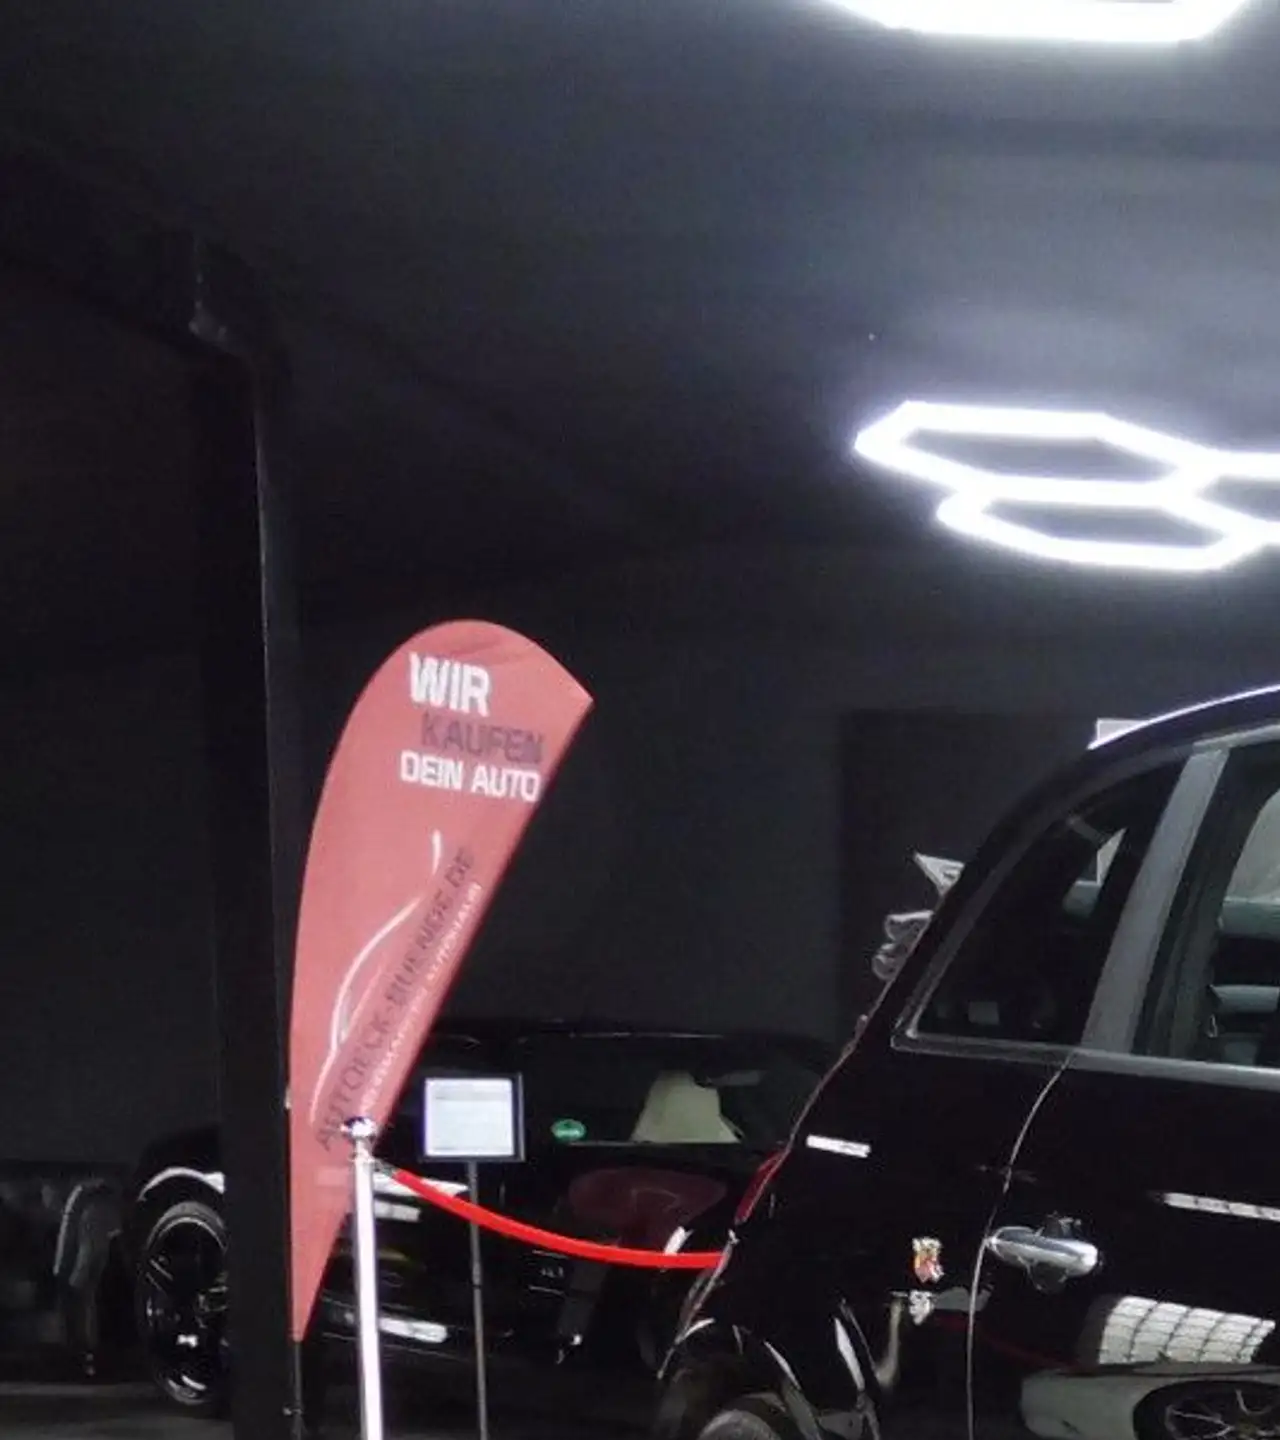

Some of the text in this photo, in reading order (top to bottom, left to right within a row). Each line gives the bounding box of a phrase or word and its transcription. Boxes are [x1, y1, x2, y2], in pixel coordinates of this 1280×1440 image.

[408, 652, 490, 718] WIR
[421, 709, 545, 763] KAUFEN
[400, 750, 542, 803] DEIN AUTO
